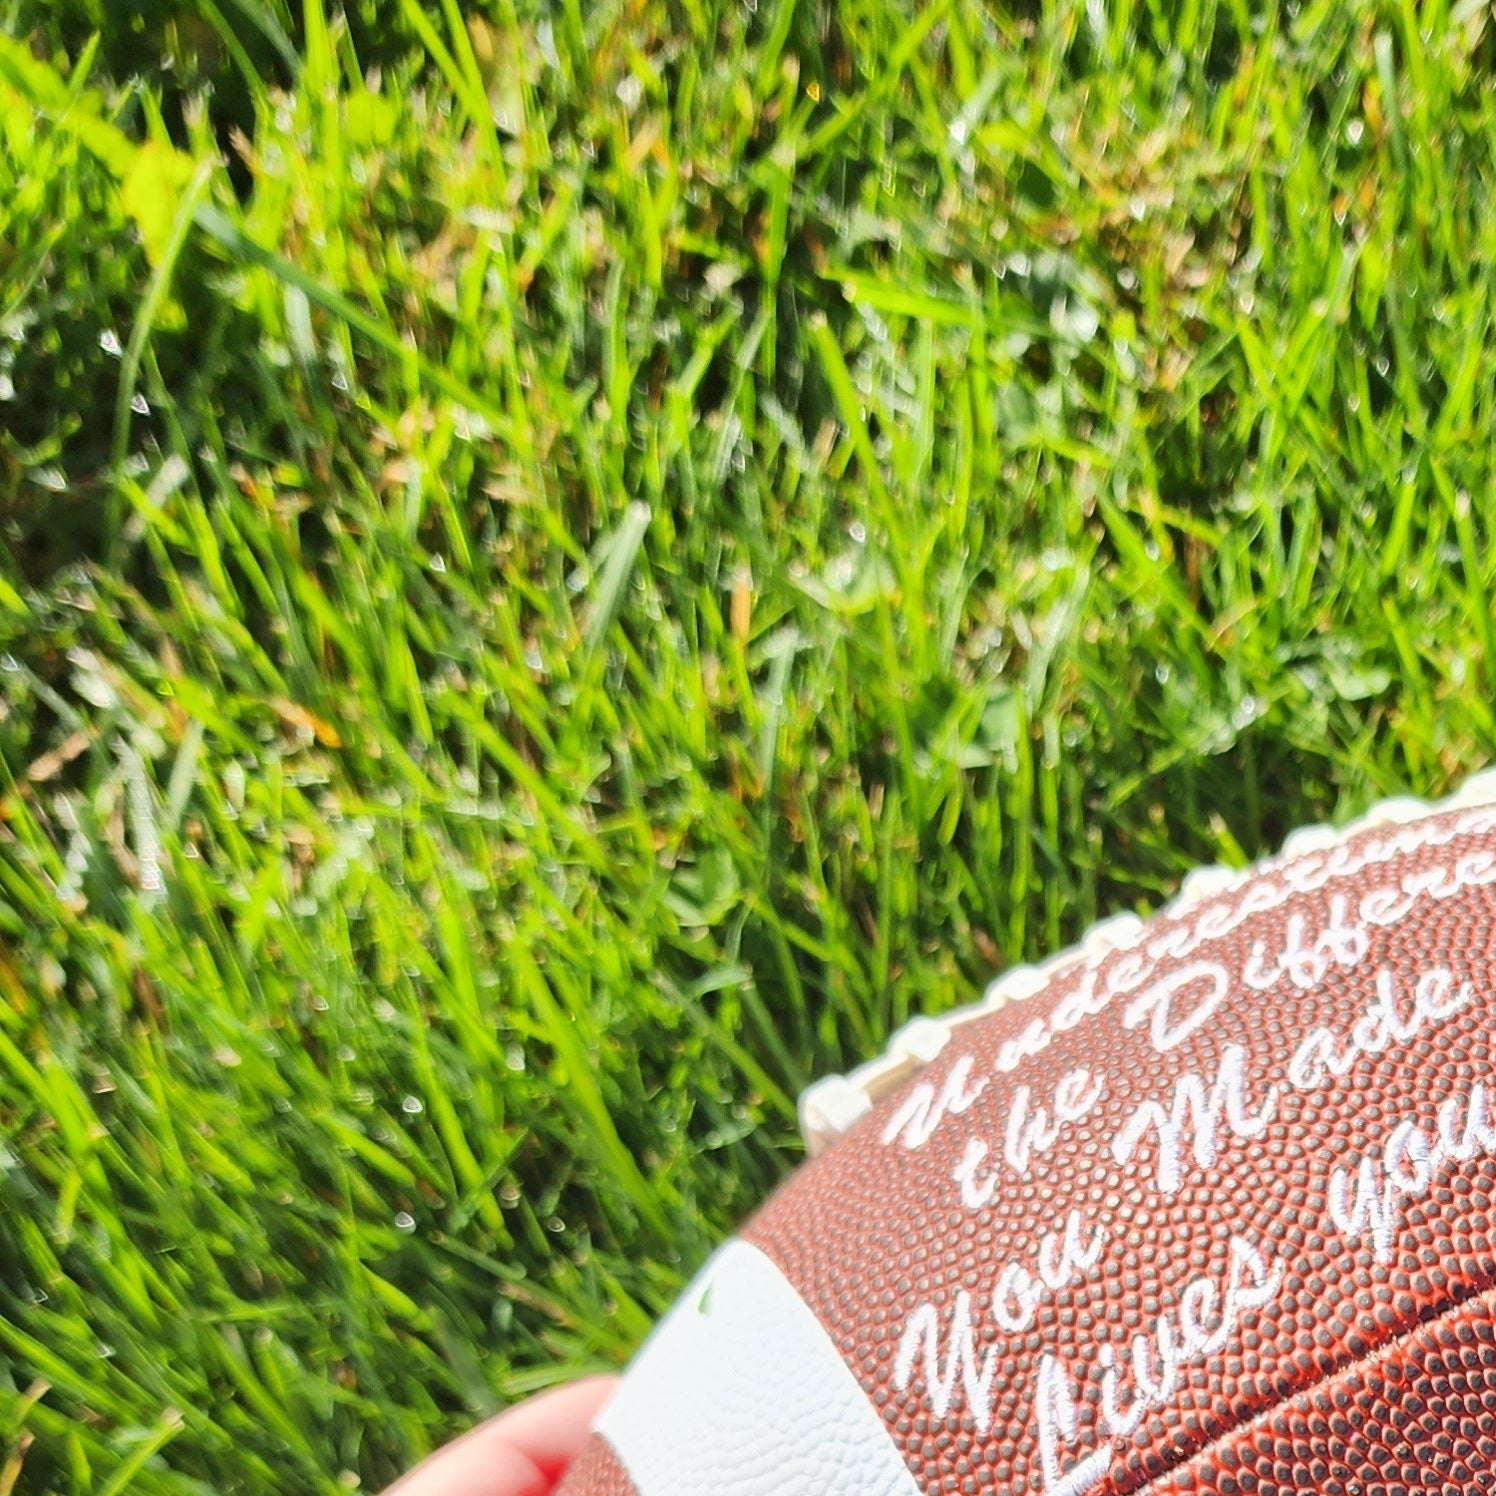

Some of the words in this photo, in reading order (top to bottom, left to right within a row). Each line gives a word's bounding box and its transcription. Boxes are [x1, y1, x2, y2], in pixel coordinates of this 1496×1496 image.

[895, 1209, 1105, 1434] You
[1112, 967, 1473, 1193] Made
[955, 1066, 1106, 1209] the
